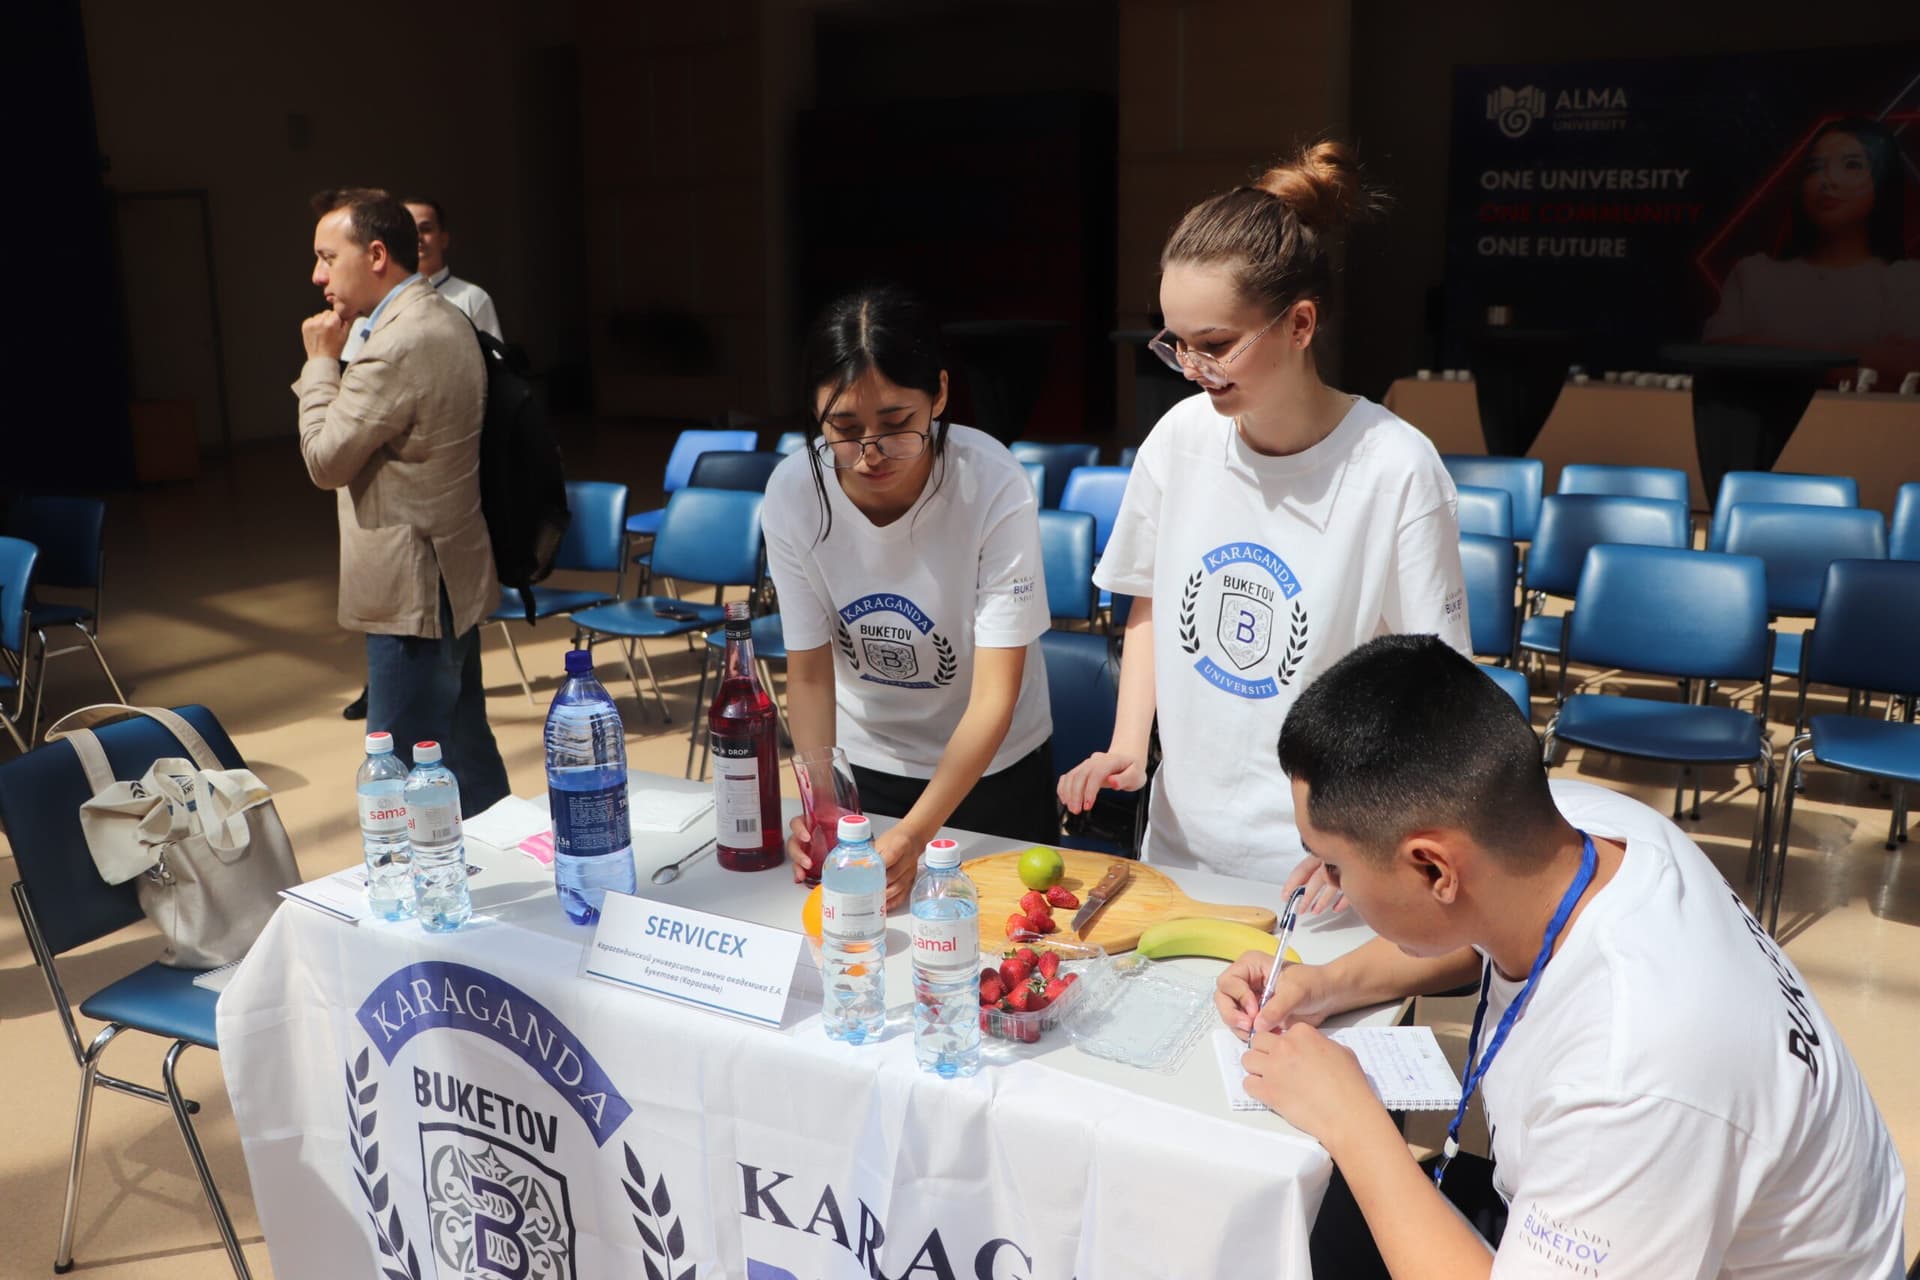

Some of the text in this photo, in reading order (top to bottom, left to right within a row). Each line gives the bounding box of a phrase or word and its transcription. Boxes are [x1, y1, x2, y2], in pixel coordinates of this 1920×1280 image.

[1554, 87, 1628, 110] ALMA
[1480, 168, 1690, 190] ONE UNIVERSITY
[1539, 203, 1701, 224] COMMUNITY
[1477, 236, 1627, 258] ONE FUTURE
[1207, 546, 1296, 595] KARAGANDA
[1223, 574, 1275, 602] BUKETOV
[843, 596, 930, 631] KARAGANDA
[860, 624, 912, 640] BUKETOV
[1204, 664, 1274, 695] UNIVERSITY
[728, 748, 749, 756] DROP
[369, 806, 407, 821] sama
[645, 915, 748, 958] SERVICEX
[644, 965, 679, 982] Букетова
[651, 955, 701, 975] университет
[372, 977, 607, 1128] KARAGANDA
[413, 1065, 558, 1154] BUKETOV
[736, 1161, 1077, 1280] KARAG
[1523, 1213, 1609, 1264] BUKETOV
